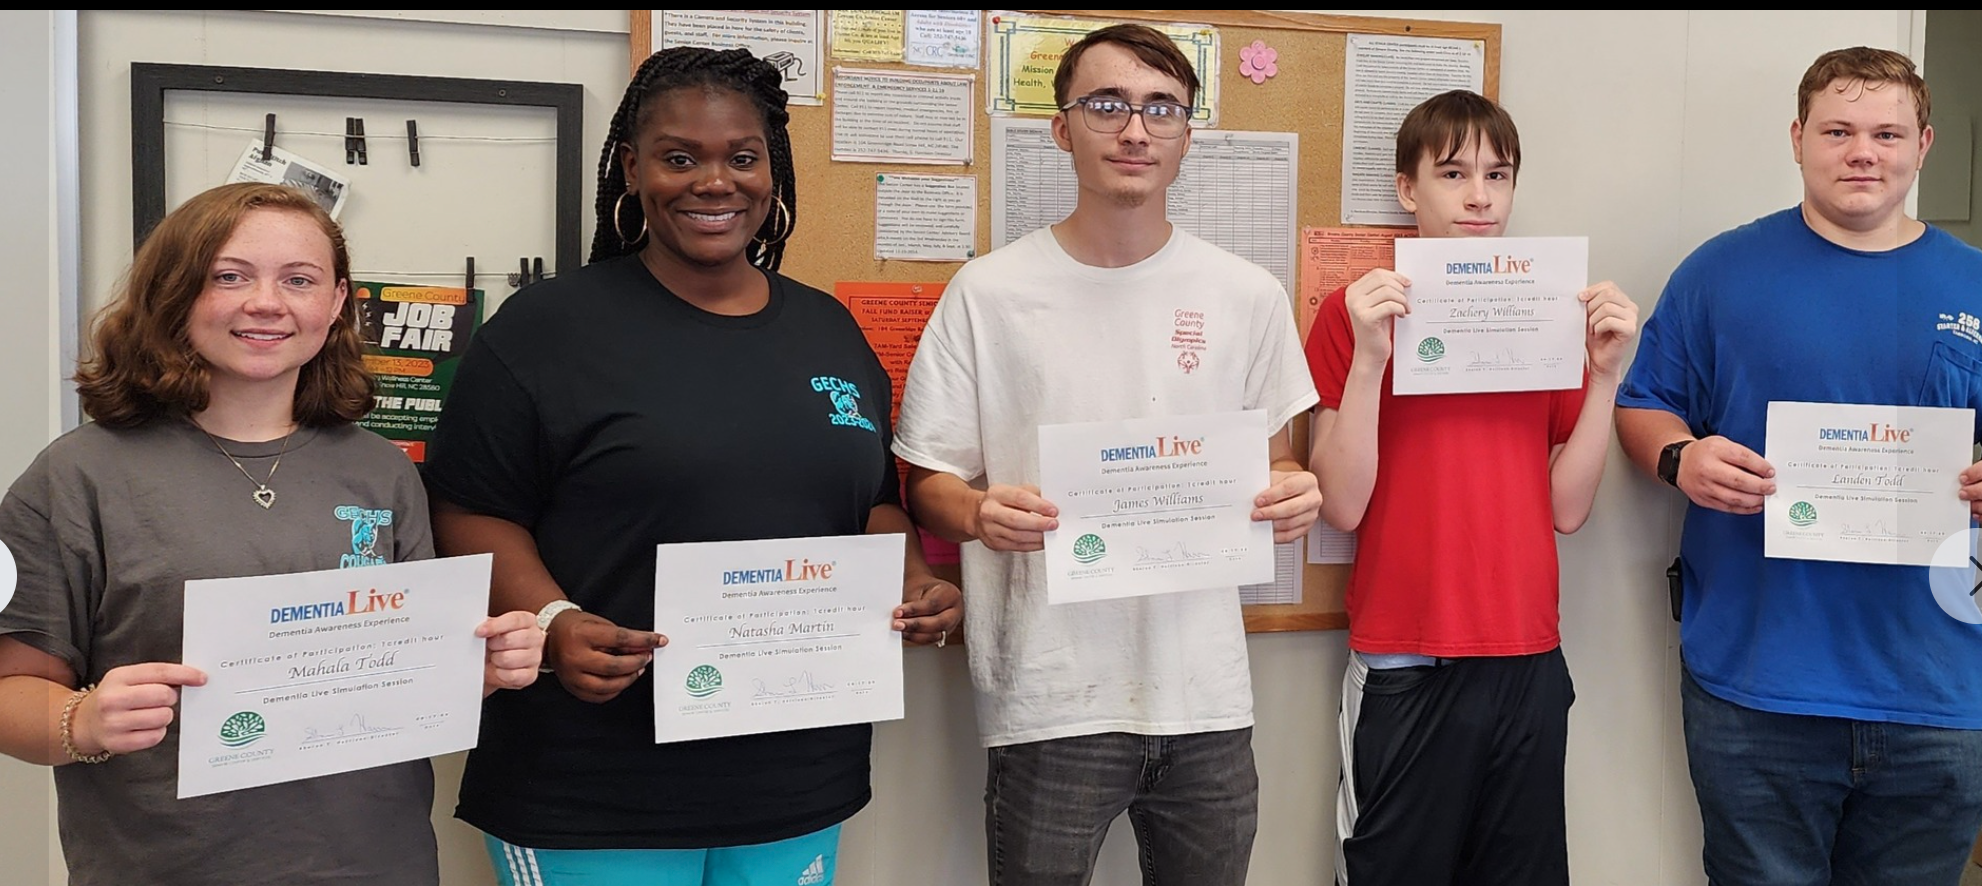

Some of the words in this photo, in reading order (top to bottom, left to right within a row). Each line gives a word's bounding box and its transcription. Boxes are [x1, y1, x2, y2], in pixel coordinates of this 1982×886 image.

[1021, 65, 1054, 74] Mission
[1013, 78, 1046, 88] Health,
[1446, 262, 1493, 275] DEMENTIA
[383, 288, 422, 300] Greene
[424, 290, 465, 303] County
[861, 299, 888, 307] GREENE
[383, 301, 456, 330] JOB
[862, 308, 878, 316] FALL
[879, 308, 898, 316] FUND
[899, 308, 923, 317] RAISER
[1174, 309, 1204, 320] Greene
[1449, 305, 1489, 319] Zachery
[1492, 304, 1535, 317] Williams
[1174, 318, 1205, 329] County
[1958, 311, 1980, 331] 258
[380, 326, 454, 352] FAIR
[1171, 336, 1206, 344] Olympics
[405, 360, 430, 369] 2023
[410, 376, 433, 384] Center
[811, 376, 860, 399] GECHS
[373, 396, 403, 409] THE
[404, 397, 442, 411] PUBL
[370, 421, 413, 431] conducting
[413, 423, 437, 431] interv
[381, 414, 418, 423] accepting
[1819, 428, 1869, 441] DEMENTIA
[1101, 446, 1156, 462] DEMENTIA
[1848, 446, 1881, 454] Awareness
[1881, 447, 1914, 455] Experience
[1101, 466, 1134, 475] Dementia
[1135, 463, 1171, 472] Awareness
[1172, 460, 1208, 470] Experience
[1875, 473, 1906, 487] Todd
[1067, 488, 1113, 497] Certificate
[1113, 498, 1149, 513] James
[1152, 492, 1204, 507] Williams
[334, 505, 393, 526] GECHS
[1101, 520, 1135, 529] Dementia
[1152, 516, 1189, 525] Simulation
[1190, 514, 1216, 522] Session
[723, 568, 783, 586] DEMENTIA
[722, 590, 758, 599] Dementia
[758, 587, 798, 597] Awareness
[799, 585, 838, 596] Experience
[270, 601, 345, 623] DEMENTIA
[683, 613, 733, 624] Certificate
[737, 612, 745, 620] of
[269, 627, 313, 639] Dementia
[314, 622, 361, 634] Awareness
[363, 616, 410, 629] Experience
[729, 620, 784, 638] Natasha
[788, 620, 835, 635] Martin
[220, 654, 282, 669] Certificate
[287, 651, 298, 660] of
[421, 634, 444, 643] hour
[719, 651, 755, 660] Dementia
[774, 646, 814, 655] Simulation
[815, 644, 843, 653] Session
[288, 657, 350, 679] Mahala
[356, 650, 400, 671] Todd
[263, 692, 308, 705] Dementia
[311, 688, 329, 699] Live
[332, 682, 379, 695] Simulation
[381, 677, 414, 688] Session
[241, 749, 274, 761] COUNTY
